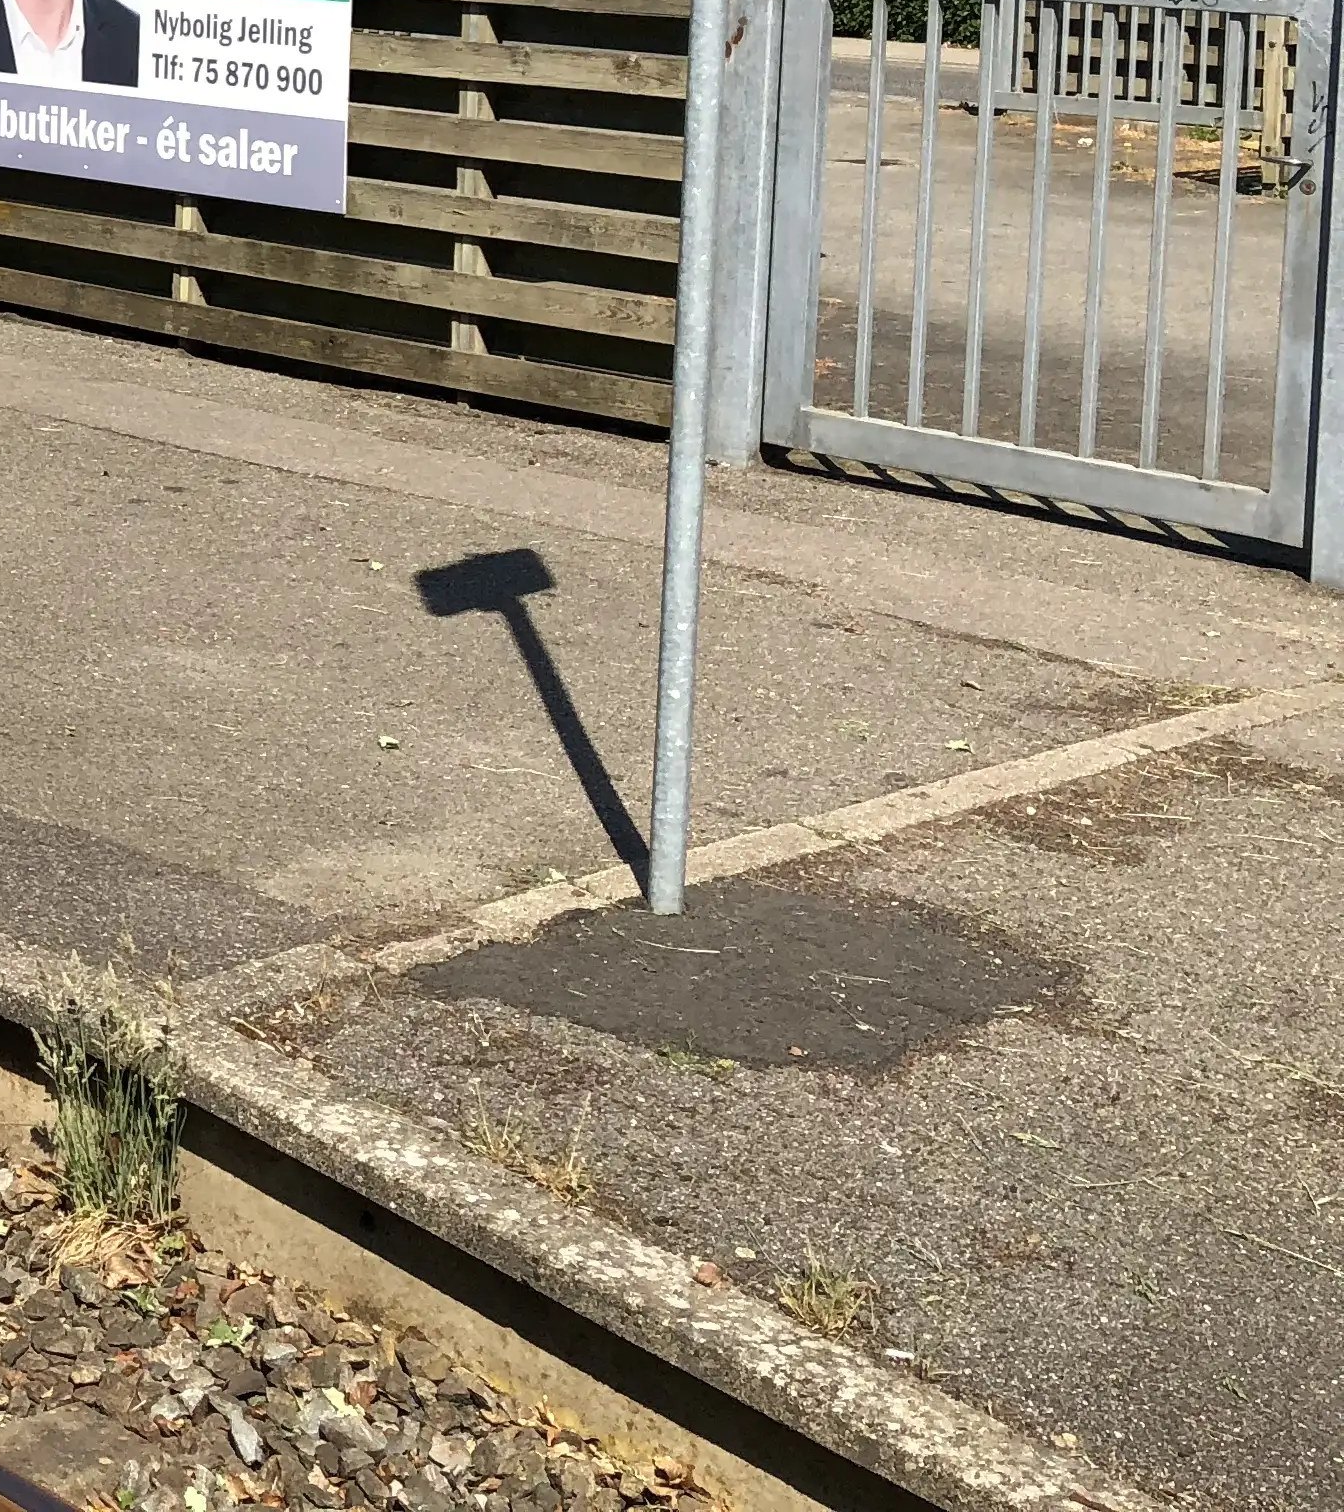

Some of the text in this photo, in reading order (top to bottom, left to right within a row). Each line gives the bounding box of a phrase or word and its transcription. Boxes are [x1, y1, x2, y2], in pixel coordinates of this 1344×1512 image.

[154, 8, 314, 54] Nybolig Jelling
[152, 53, 323, 96] Tlf: 75 870 900
[0, 97, 129, 154] butikker
[156, 115, 191, 161] ét
[197, 130, 299, 176] salær
